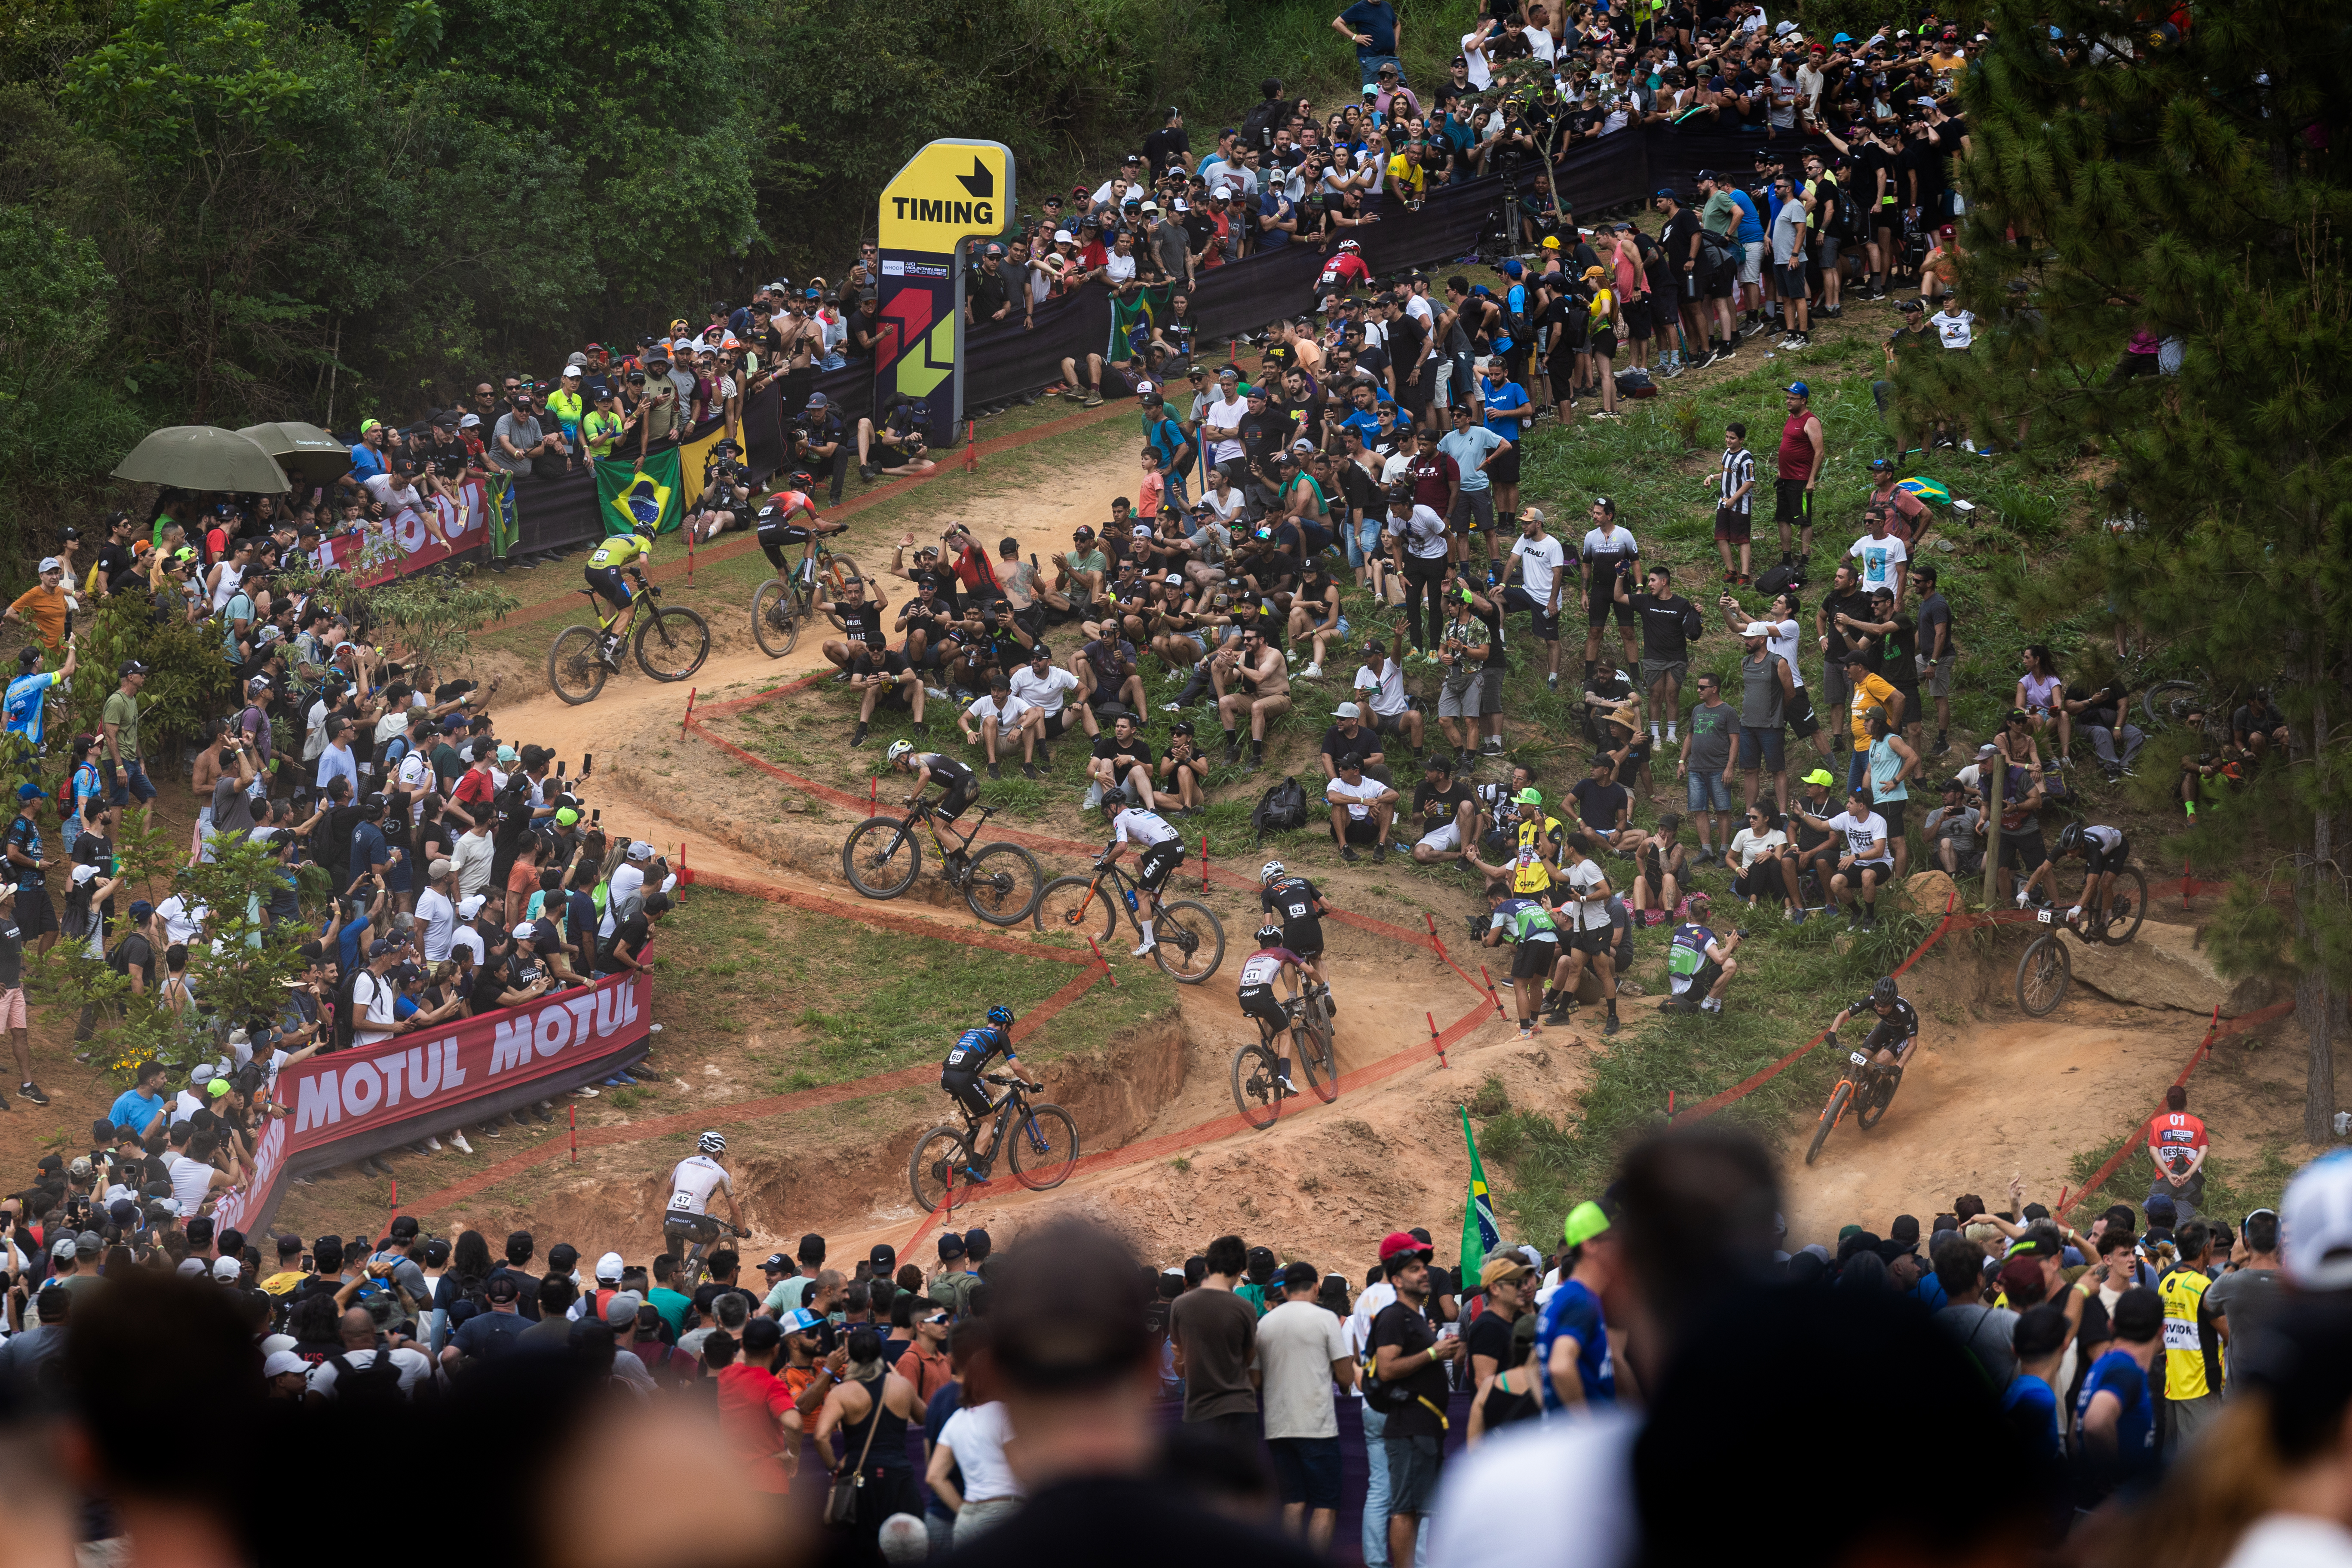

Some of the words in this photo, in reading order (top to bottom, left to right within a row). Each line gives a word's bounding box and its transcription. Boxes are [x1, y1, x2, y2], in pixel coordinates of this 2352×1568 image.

[892, 198, 994, 224] TIMING
[1376, 443, 1389, 453] NIKE
[850, 632, 865, 641] RIDE
[936, 768, 955, 778] syncros
[938, 807, 955, 818] SCOTT
[1176, 845, 1185, 853] BH
[1144, 857, 1160, 879] BH
[1674, 947, 1690, 956] PHOTO
[1897, 1039, 1908, 1054] KTM
[294, 1035, 467, 1134] MOTUL
[488, 975, 638, 1076] MOTUL
[1852, 1055, 1864, 1064] 39
[972, 1083, 992, 1105] BULLS
[2169, 1114, 2185, 1126] 01
[686, 1160, 715, 1169] GERMANY
